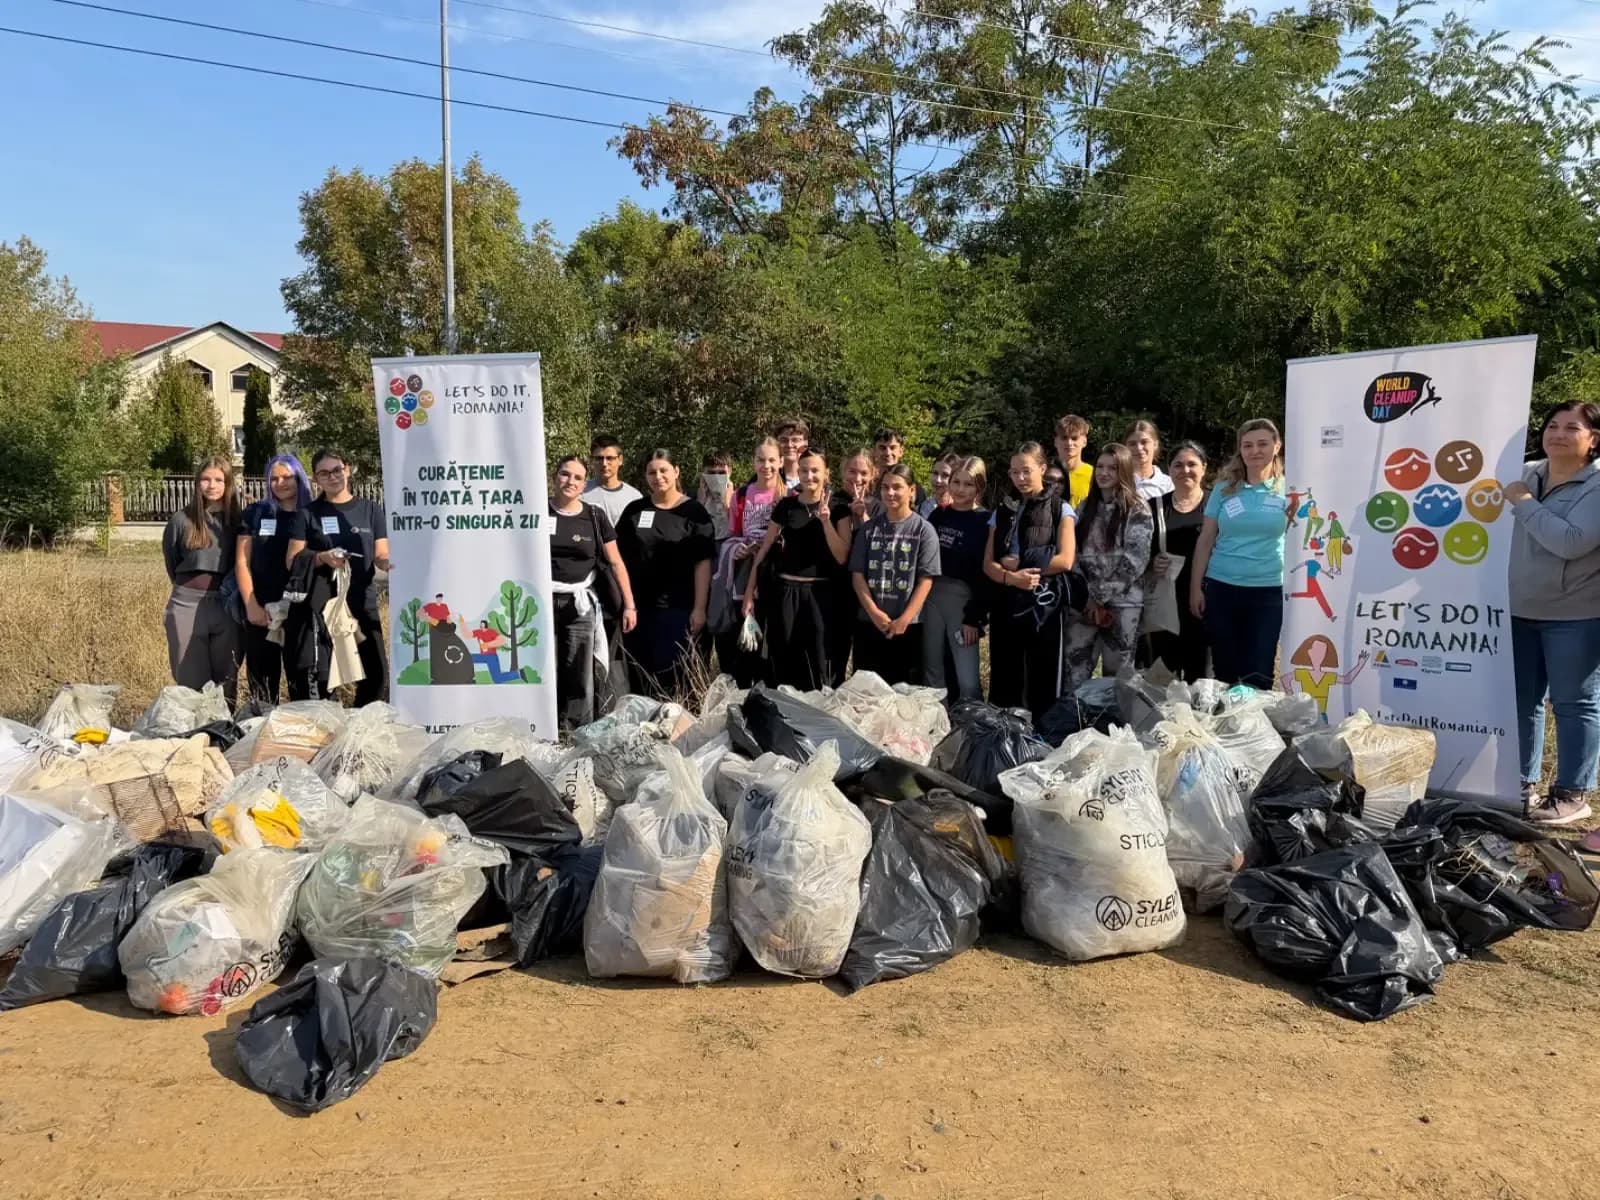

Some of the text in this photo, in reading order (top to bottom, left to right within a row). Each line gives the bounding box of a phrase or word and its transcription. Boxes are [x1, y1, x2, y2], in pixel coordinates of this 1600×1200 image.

[444, 385, 486, 399] LET'S
[490, 384, 509, 398] DO
[1376, 376, 1411, 392] WORLD
[1373, 389, 1418, 406] CLEANUP
[452, 401, 524, 415] ROMANIA!
[1371, 405, 1392, 420] DAY
[418, 460, 505, 486] CURĂȚENIE
[402, 484, 525, 511] ÎN TOATĂ ȚARA
[391, 511, 440, 531] ÎNTR-O
[446, 509, 515, 530] SINGURĂ
[1356, 600, 1505, 628] LET'S DO IT
[1364, 627, 1499, 655] ROMANIA!
